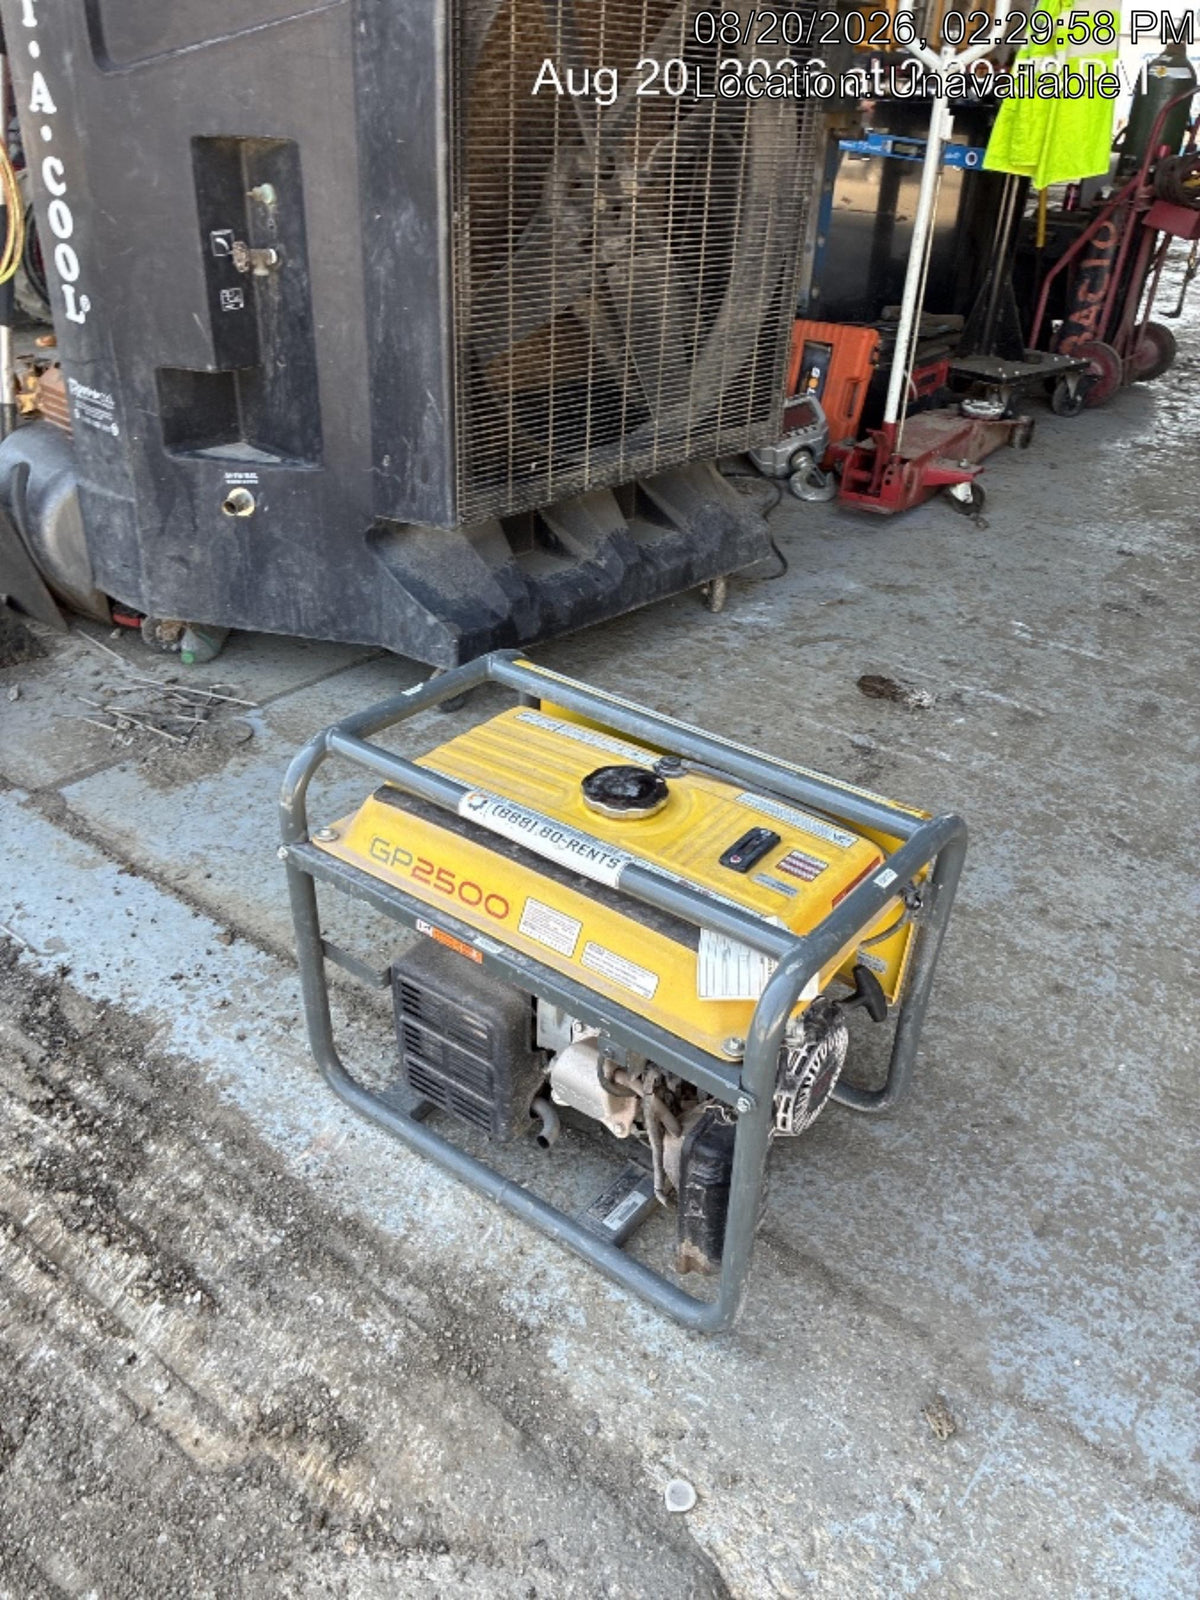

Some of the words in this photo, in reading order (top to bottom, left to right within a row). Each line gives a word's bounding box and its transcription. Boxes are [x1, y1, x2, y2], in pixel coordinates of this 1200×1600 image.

[491, 804, 538, 833] (888)
[539, 826, 622, 870] 80-RENTS
[369, 836, 510, 920] GP2500
